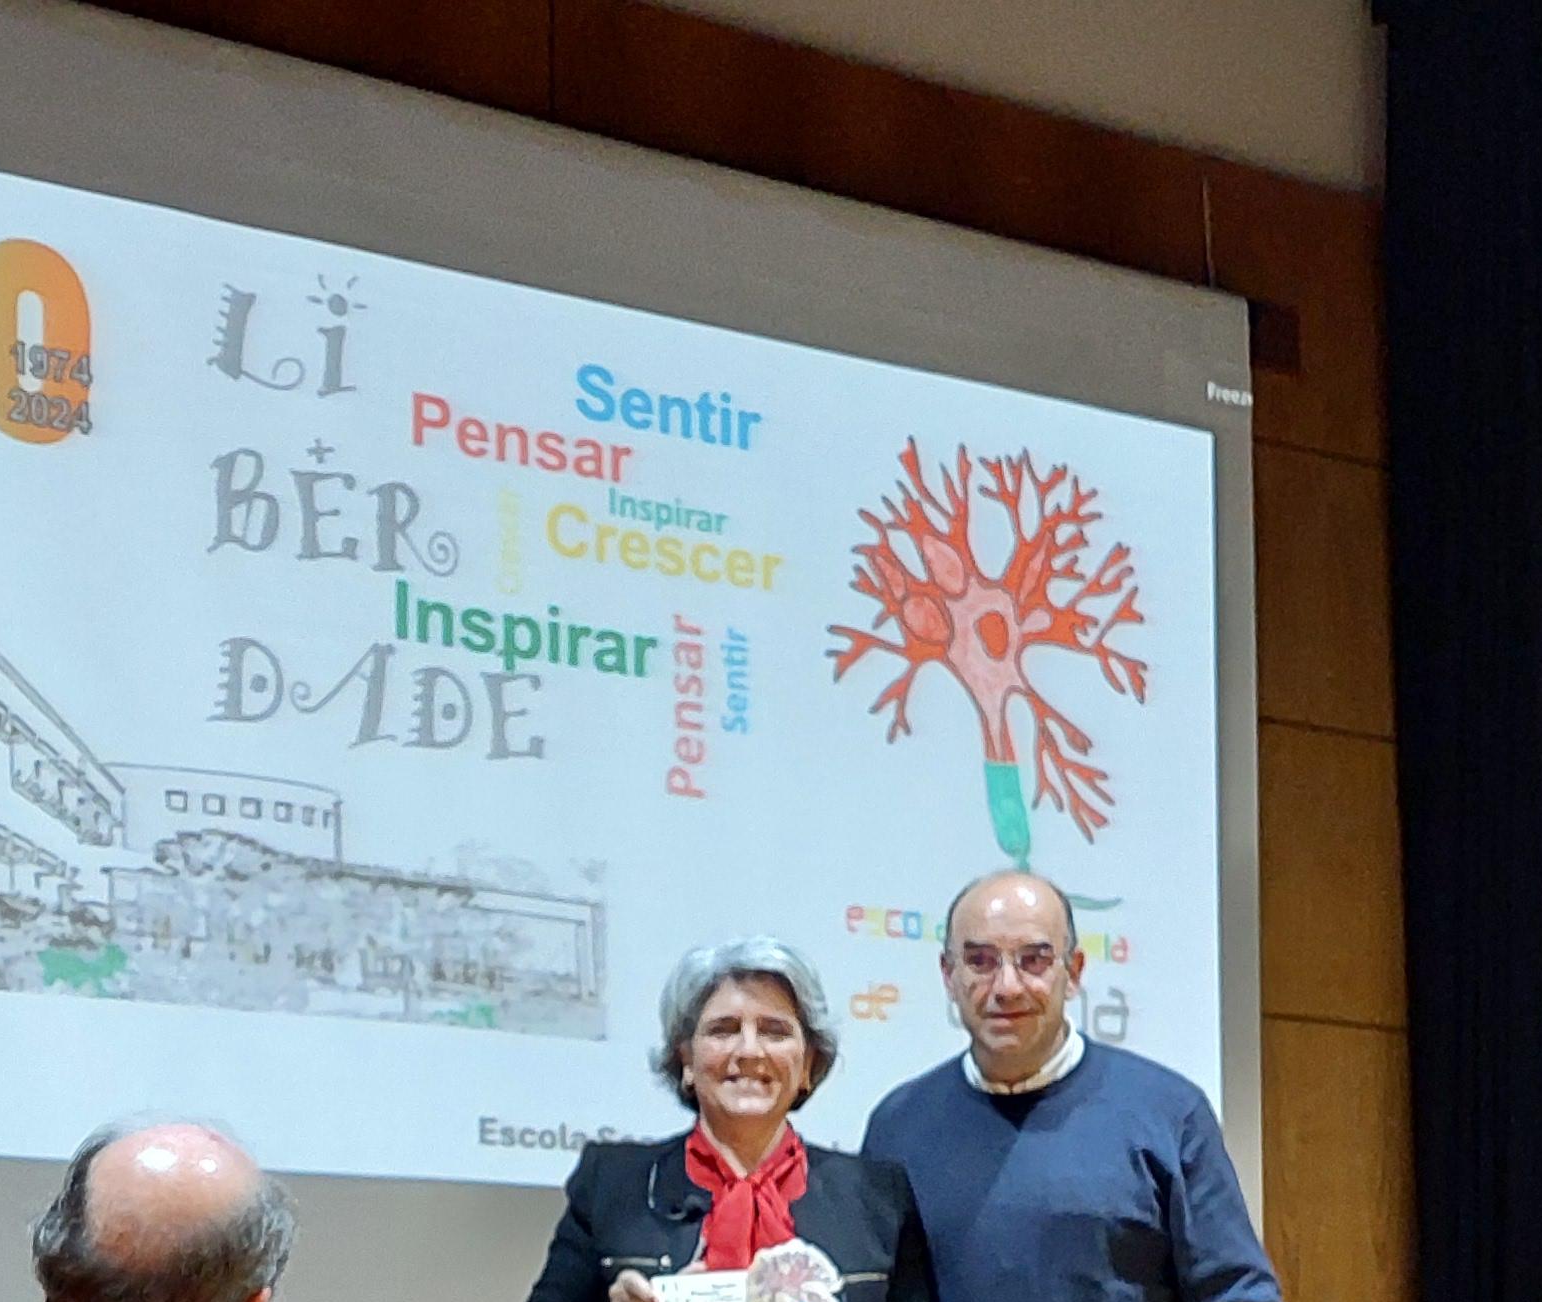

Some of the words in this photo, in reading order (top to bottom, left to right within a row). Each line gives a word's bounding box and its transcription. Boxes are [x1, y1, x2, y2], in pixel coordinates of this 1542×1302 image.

[9, 340, 94, 390] 1974
[575, 363, 763, 451] Sentir
[7, 386, 95, 436] 2024
[410, 391, 633, 484] Pensar
[545, 502, 784, 592] Crescer
[608, 487, 730, 535] Inspirar
[393, 579, 658, 679] Inspirar
[666, 613, 706, 800] Pensar
[720, 626, 751, 736] Sentir
